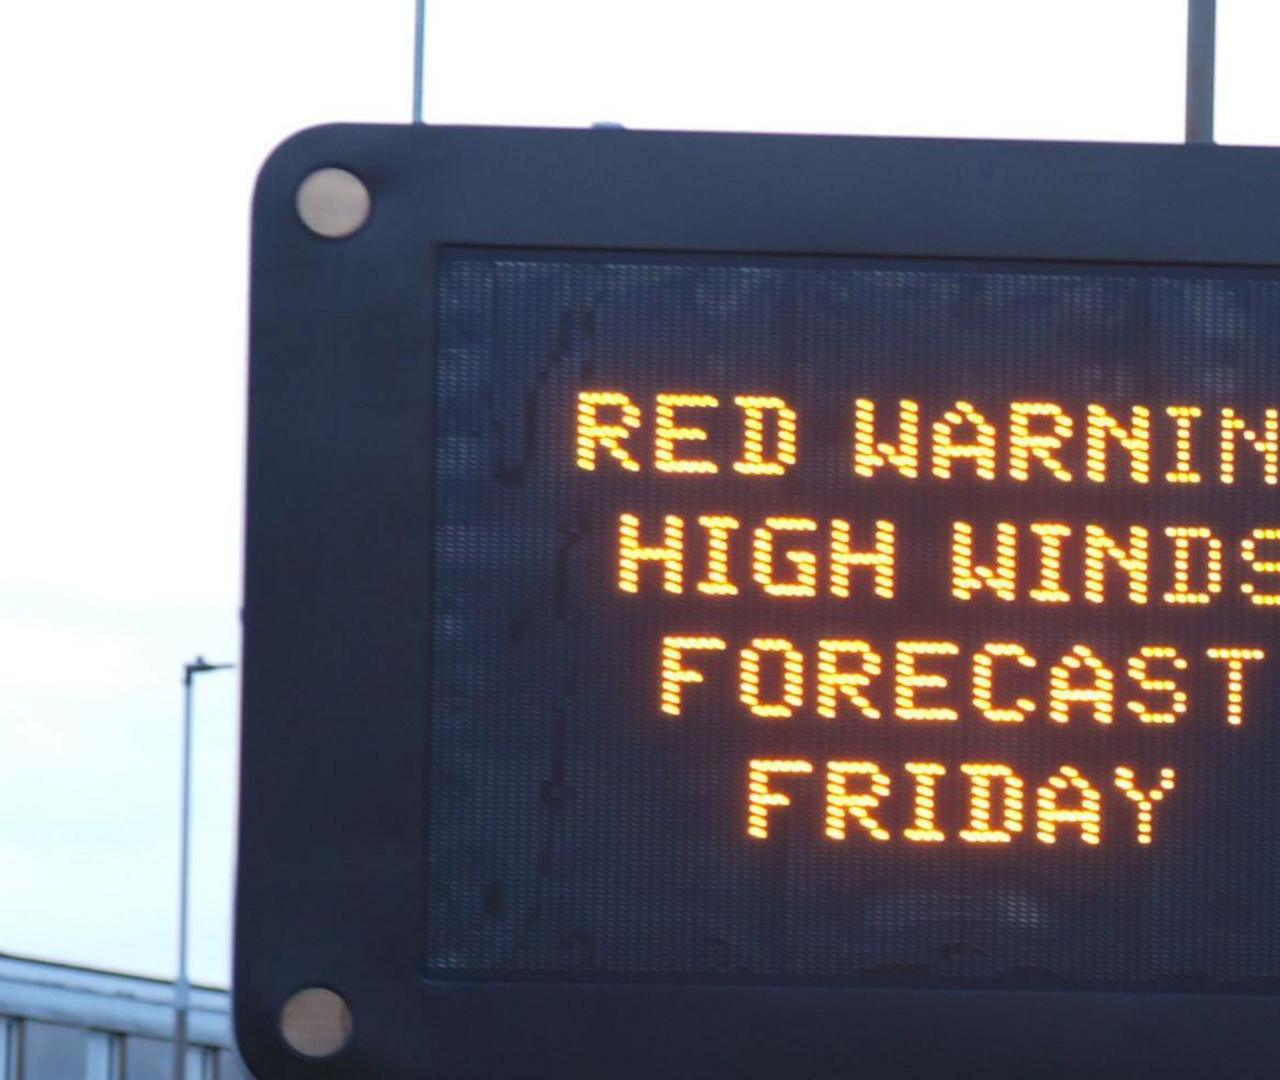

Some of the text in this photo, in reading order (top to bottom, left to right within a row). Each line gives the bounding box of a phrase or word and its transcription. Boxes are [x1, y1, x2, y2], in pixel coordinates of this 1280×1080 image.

[576, 391, 798, 476] RED
[618, 513, 895, 599] HIGH
[661, 635, 1265, 725] FORECAST
[747, 758, 1175, 845] FRIDAY
